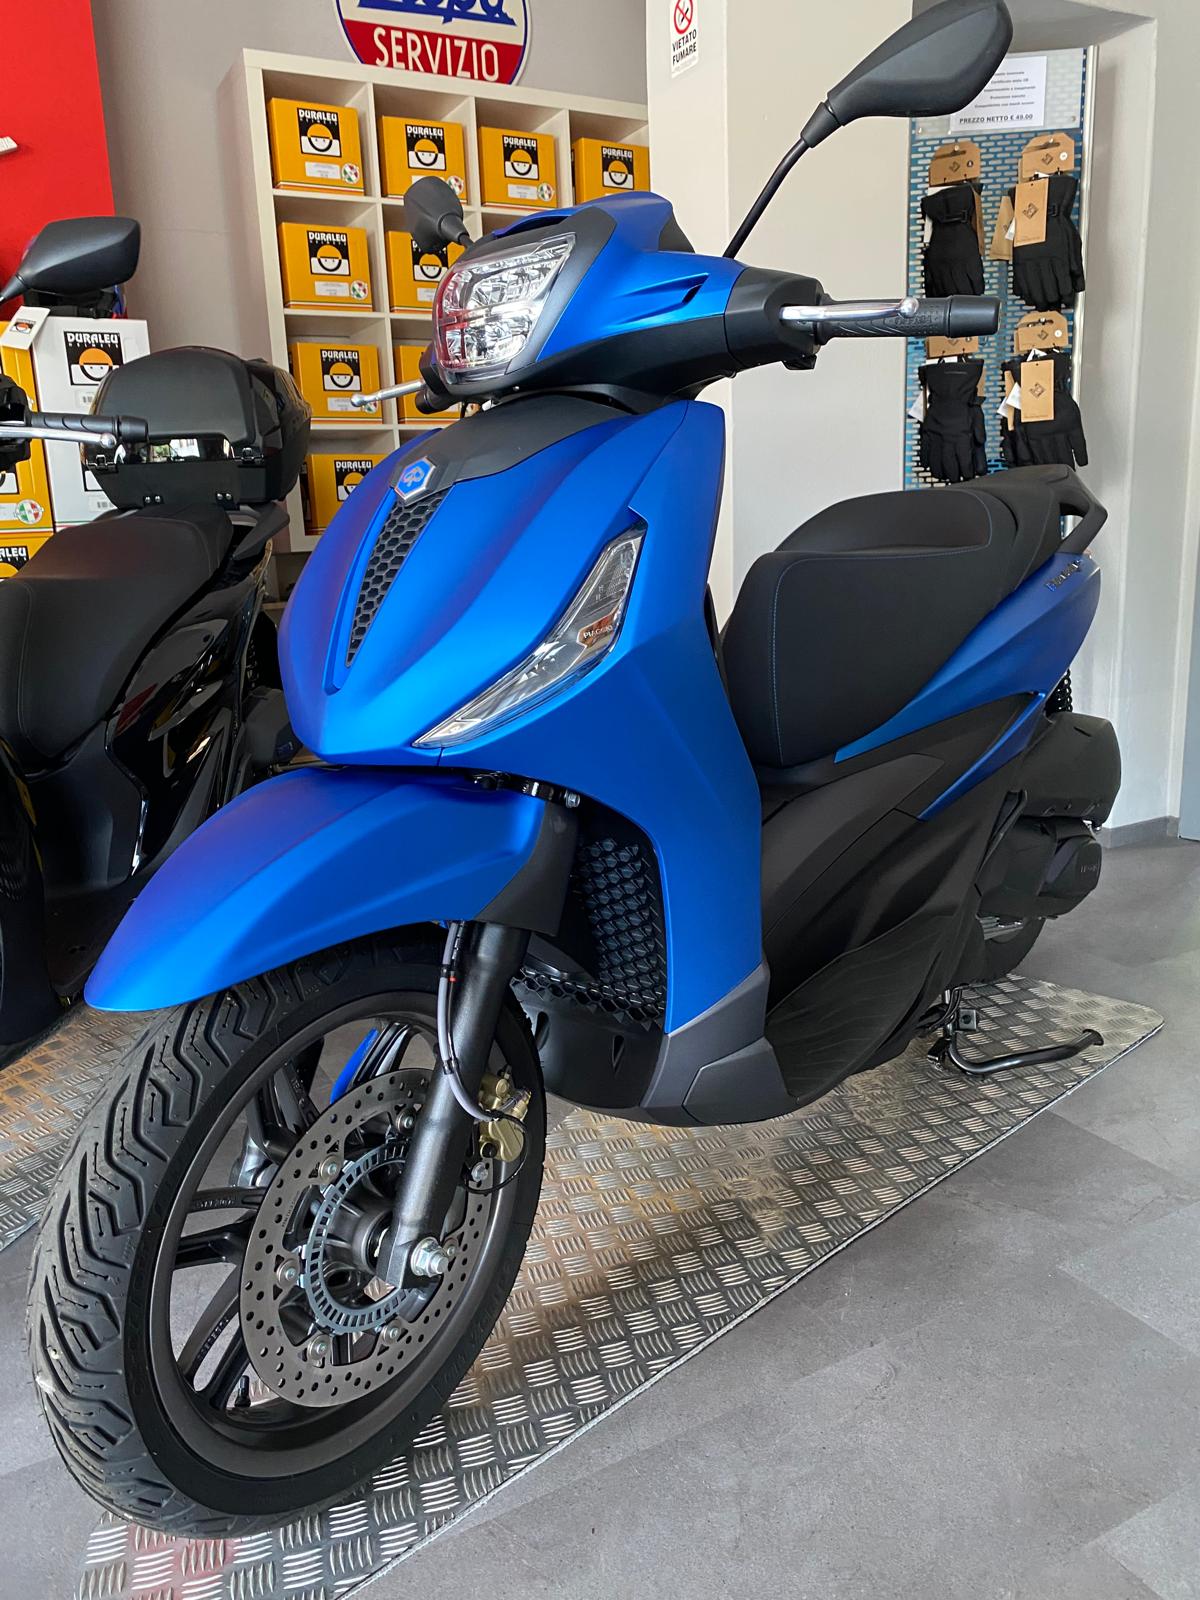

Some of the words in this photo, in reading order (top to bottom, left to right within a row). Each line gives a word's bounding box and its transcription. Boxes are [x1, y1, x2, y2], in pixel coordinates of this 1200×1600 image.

[672, 29, 697, 52] VIETATO
[373, 26, 500, 82] SERVIZIO
[672, 42, 697, 66] FUMARE
[298, 109, 338, 122] DURALEU
[406, 125, 443, 136] DURALEU
[503, 136, 537, 147] DURALEU
[308, 232, 347, 242] DURALEU
[66, 332, 119, 344] DURALEU
[321, 350, 358, 360] DURALEU
[335, 460, 372, 470] DURALEU
